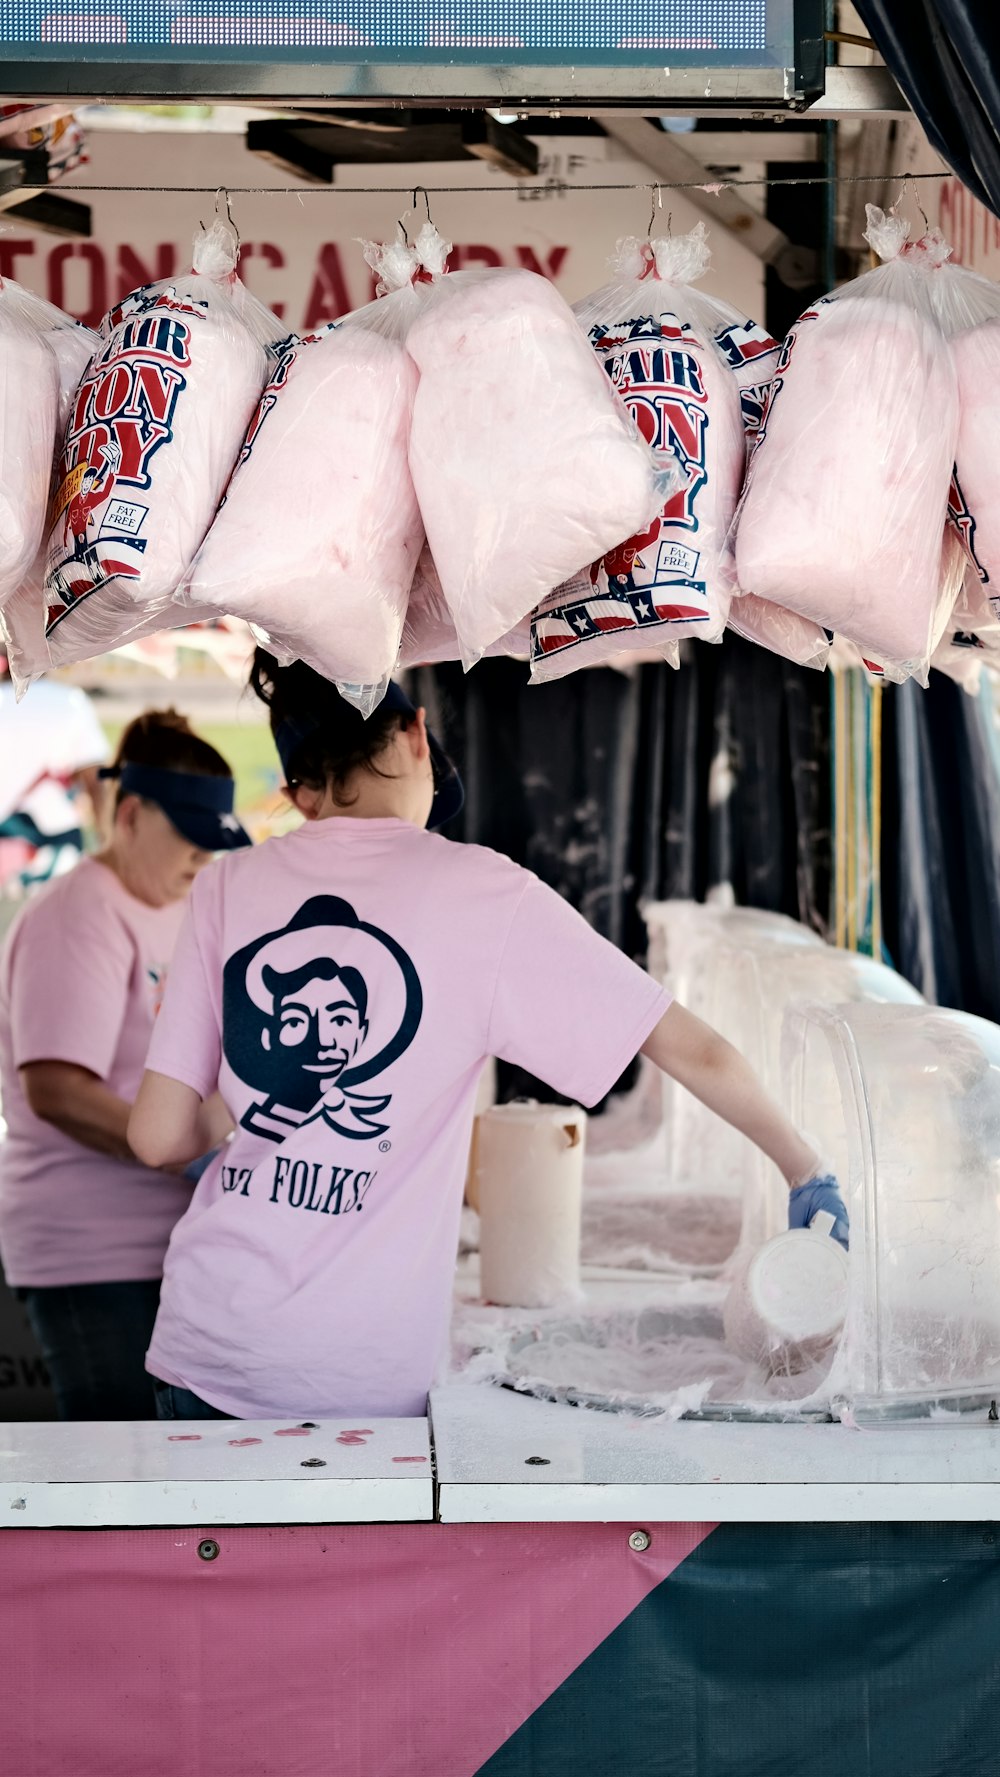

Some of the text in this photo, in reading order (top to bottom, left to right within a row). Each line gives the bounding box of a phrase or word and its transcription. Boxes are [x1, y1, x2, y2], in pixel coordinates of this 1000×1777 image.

[604, 348, 707, 400] FAIR
[116, 505, 137, 517] FAT
[108, 513, 136, 528] FREE
[669, 547, 689, 560] FAT
[663, 556, 690, 571] FREE
[269, 1156, 378, 1215] FOLKS!
